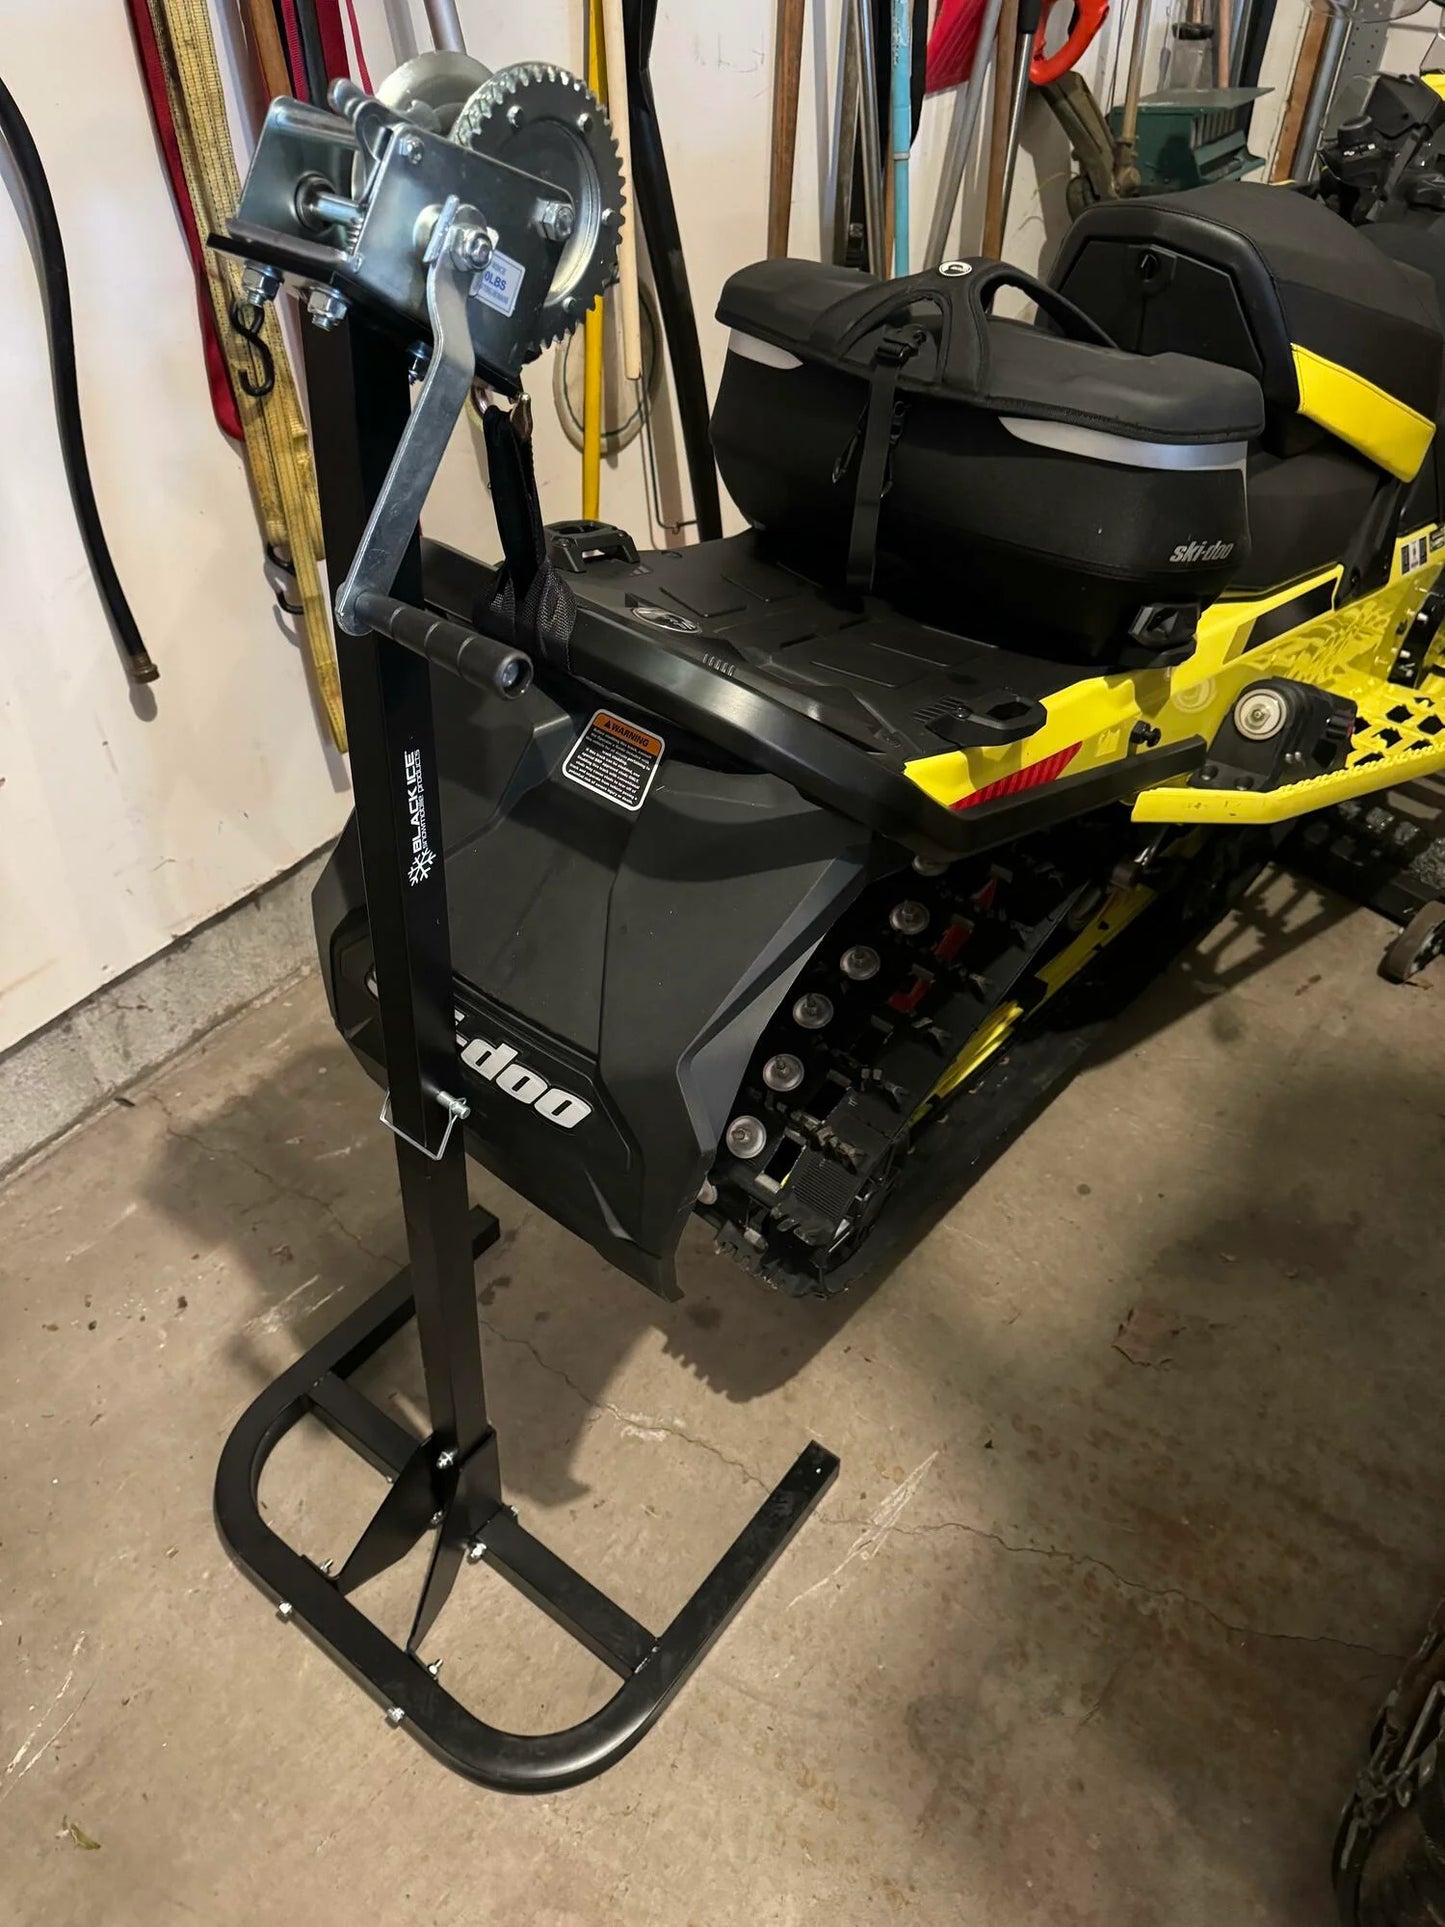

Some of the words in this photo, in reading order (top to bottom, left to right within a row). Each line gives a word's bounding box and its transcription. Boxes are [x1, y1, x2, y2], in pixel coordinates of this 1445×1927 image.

[484, 271, 507, 291] 0LBS
[1169, 540, 1234, 562] ski-doo
[612, 723, 649, 746] WARNING
[404, 751, 416, 786] ICE
[414, 749, 424, 793] products
[407, 786, 422, 853] BLACK
[455, 1009, 592, 1129] -doo
